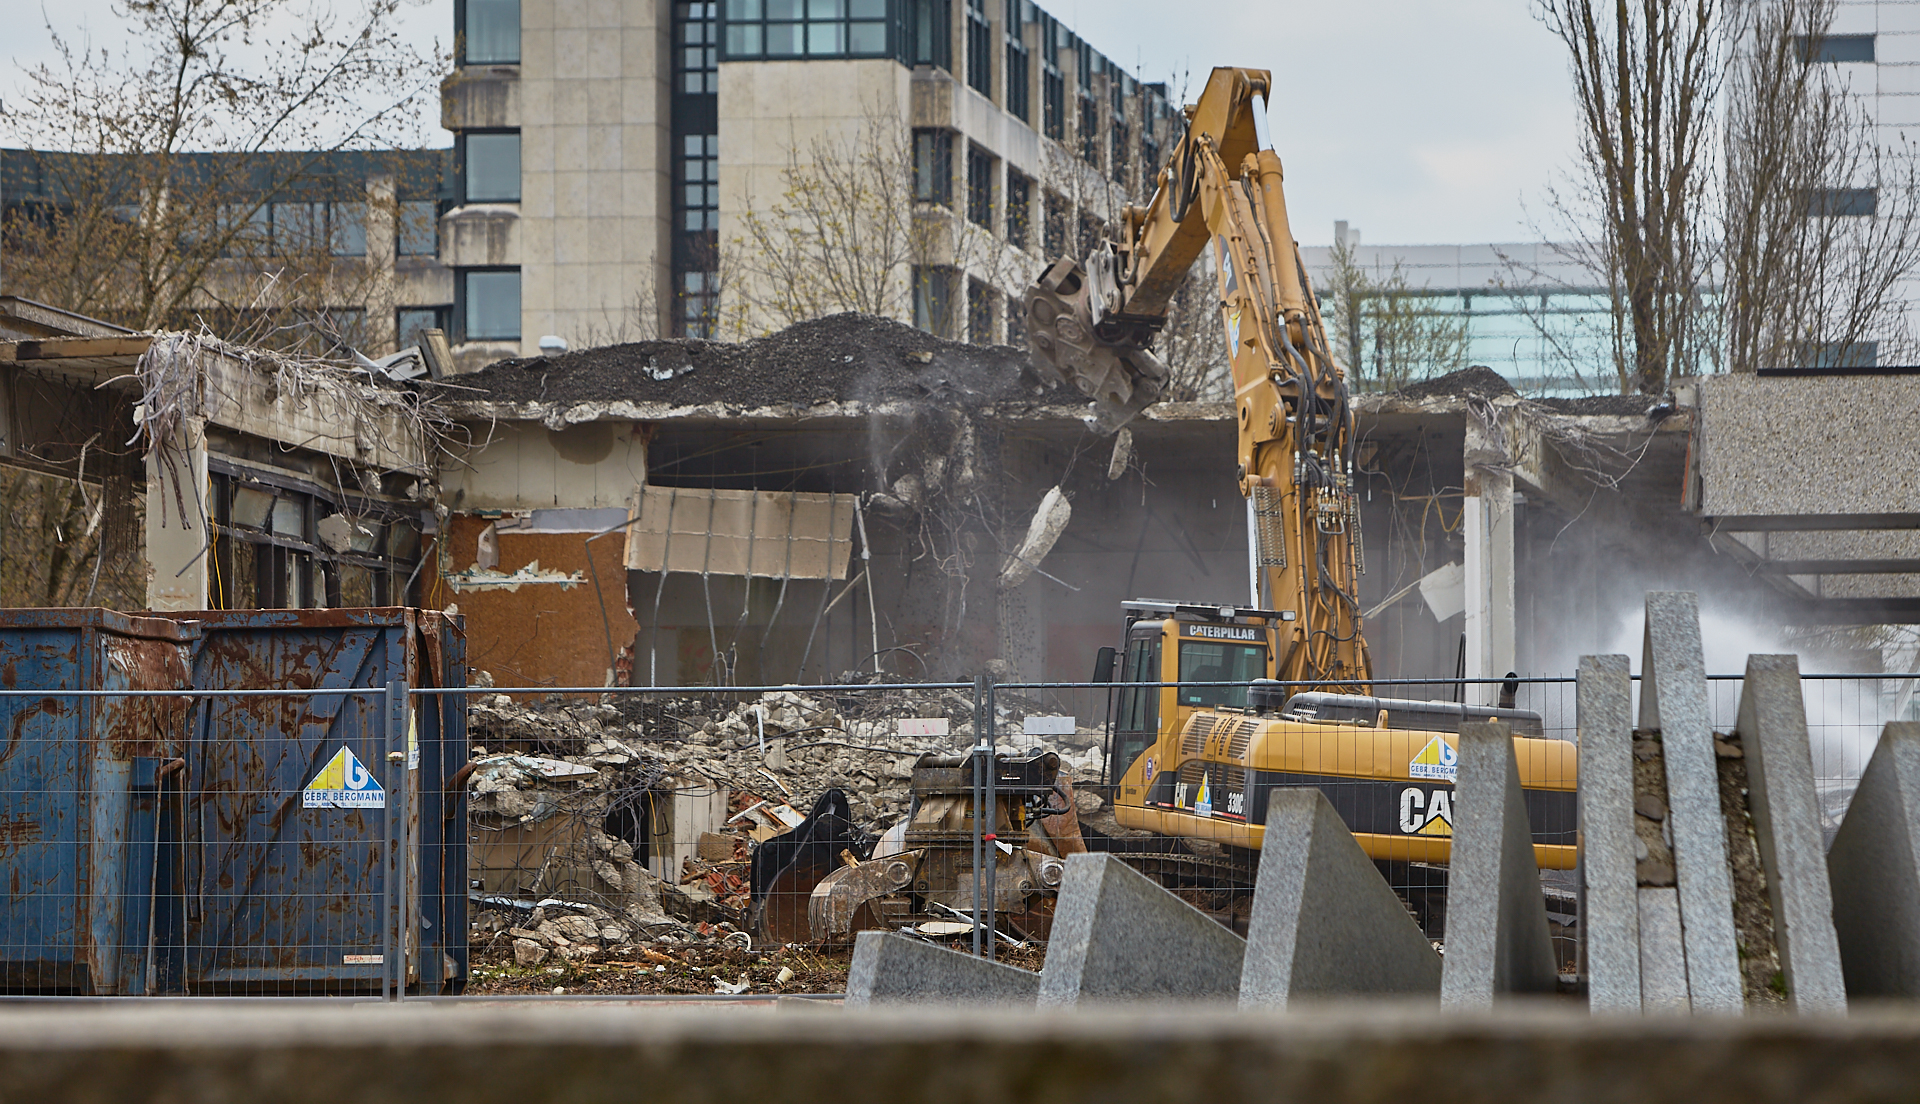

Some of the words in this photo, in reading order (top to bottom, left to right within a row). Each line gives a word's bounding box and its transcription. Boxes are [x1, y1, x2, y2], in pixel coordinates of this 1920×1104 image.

[1189, 625, 1255, 640] CATERPILLAR
[333, 792, 384, 801] BERGMANN
[1174, 782, 1188, 808] CAT
[1227, 791, 1244, 814] 330C
[1399, 787, 1456, 833] CA
